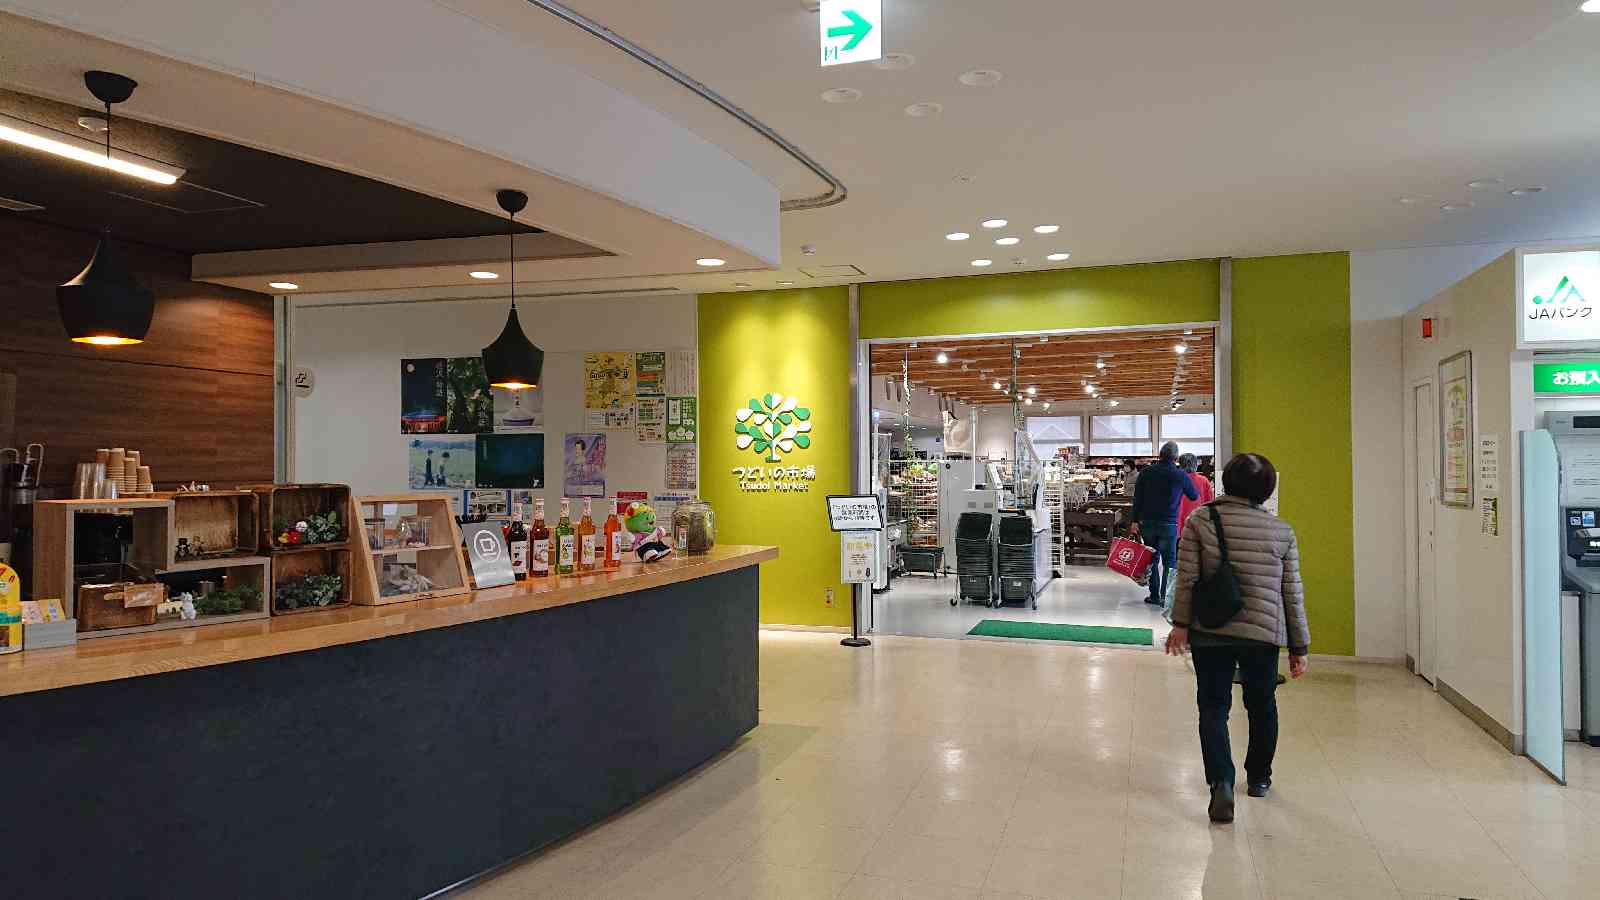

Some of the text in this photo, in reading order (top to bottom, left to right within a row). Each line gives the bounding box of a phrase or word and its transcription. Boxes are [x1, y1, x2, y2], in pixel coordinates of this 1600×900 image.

[1529, 306, 1593, 320] JAバンク
[731, 466, 816, 480] つどいの市場
[740, 481, 809, 491] Tsudoi Market
